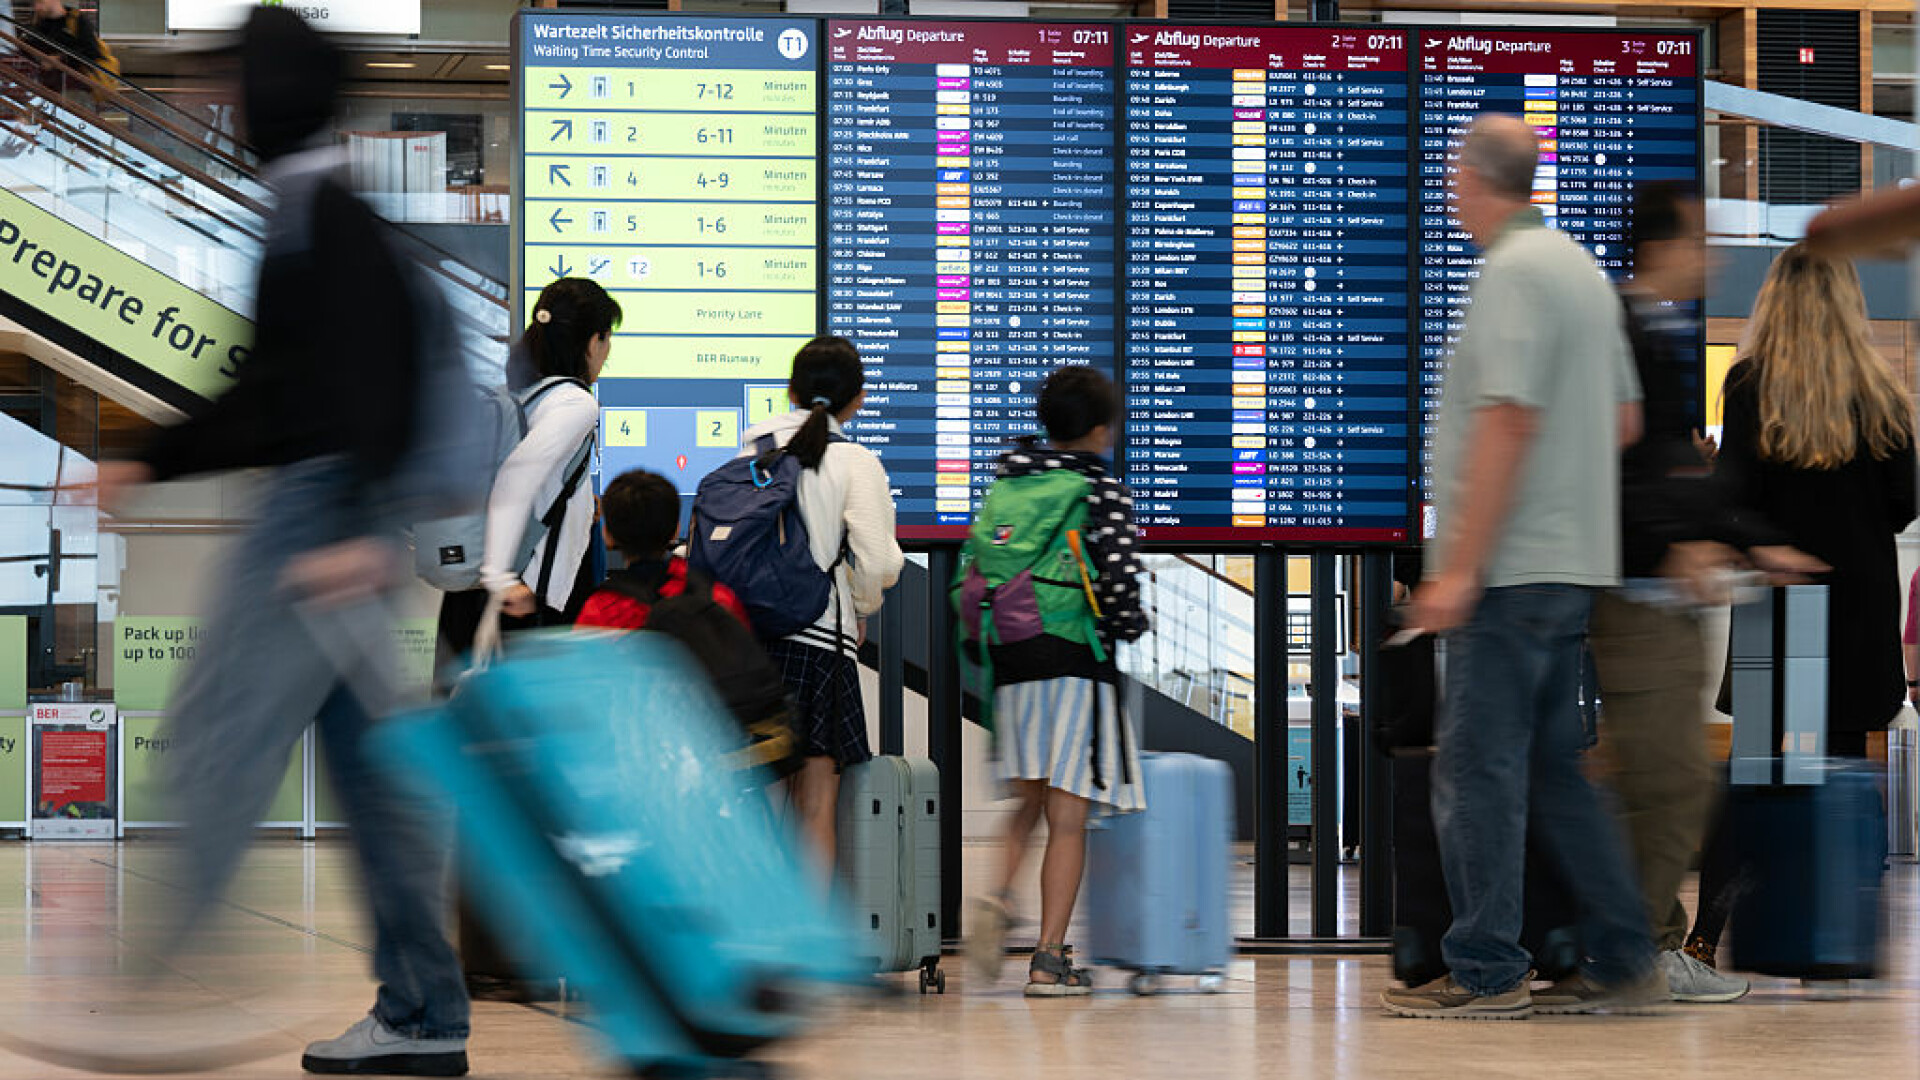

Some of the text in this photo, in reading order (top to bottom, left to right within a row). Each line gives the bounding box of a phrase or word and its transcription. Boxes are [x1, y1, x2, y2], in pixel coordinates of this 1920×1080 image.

[534, 24, 764, 42] Wartezeit Sicherheitskontrolle
[857, 26, 903, 43] Abflug
[907, 30, 964, 43] Departure
[1039, 30, 1045, 43] 1
[1074, 31, 1108, 43] 07:11
[1155, 32, 1200, 48] Abflug
[1204, 35, 1260, 48] Departure
[1332, 36, 1339, 47] 2
[1368, 36, 1403, 49] 07:11
[784, 37, 802, 51] T1
[1448, 37, 1492, 53] Abflug
[1496, 40, 1551, 52] Departure
[1622, 41, 1629, 53] 3
[1657, 41, 1690, 55] 07:11
[534, 46, 709, 60] Waiting Time Security Control
[628, 81, 807, 100] 1 7-12 Minuten
[628, 126, 807, 143] 2 6-11 Minuten
[628, 170, 807, 188] 4 4-9 Minuten
[628, 215, 807, 232] 5 1-6 Minuten
[630, 260, 807, 278] T2 1-6 Minuten
[697, 310, 762, 320] Priority Lane
[151, 306, 216, 361] for
[697, 354, 760, 364] BER Runway
[766, 399, 772, 412] 1
[620, 421, 630, 436] 4
[712, 422, 722, 436] 2
[124, 627, 158, 641] Pack
[165, 629, 184, 644] up
[124, 647, 144, 661] up
[149, 646, 164, 659] to
[36, 709, 59, 719] BER
